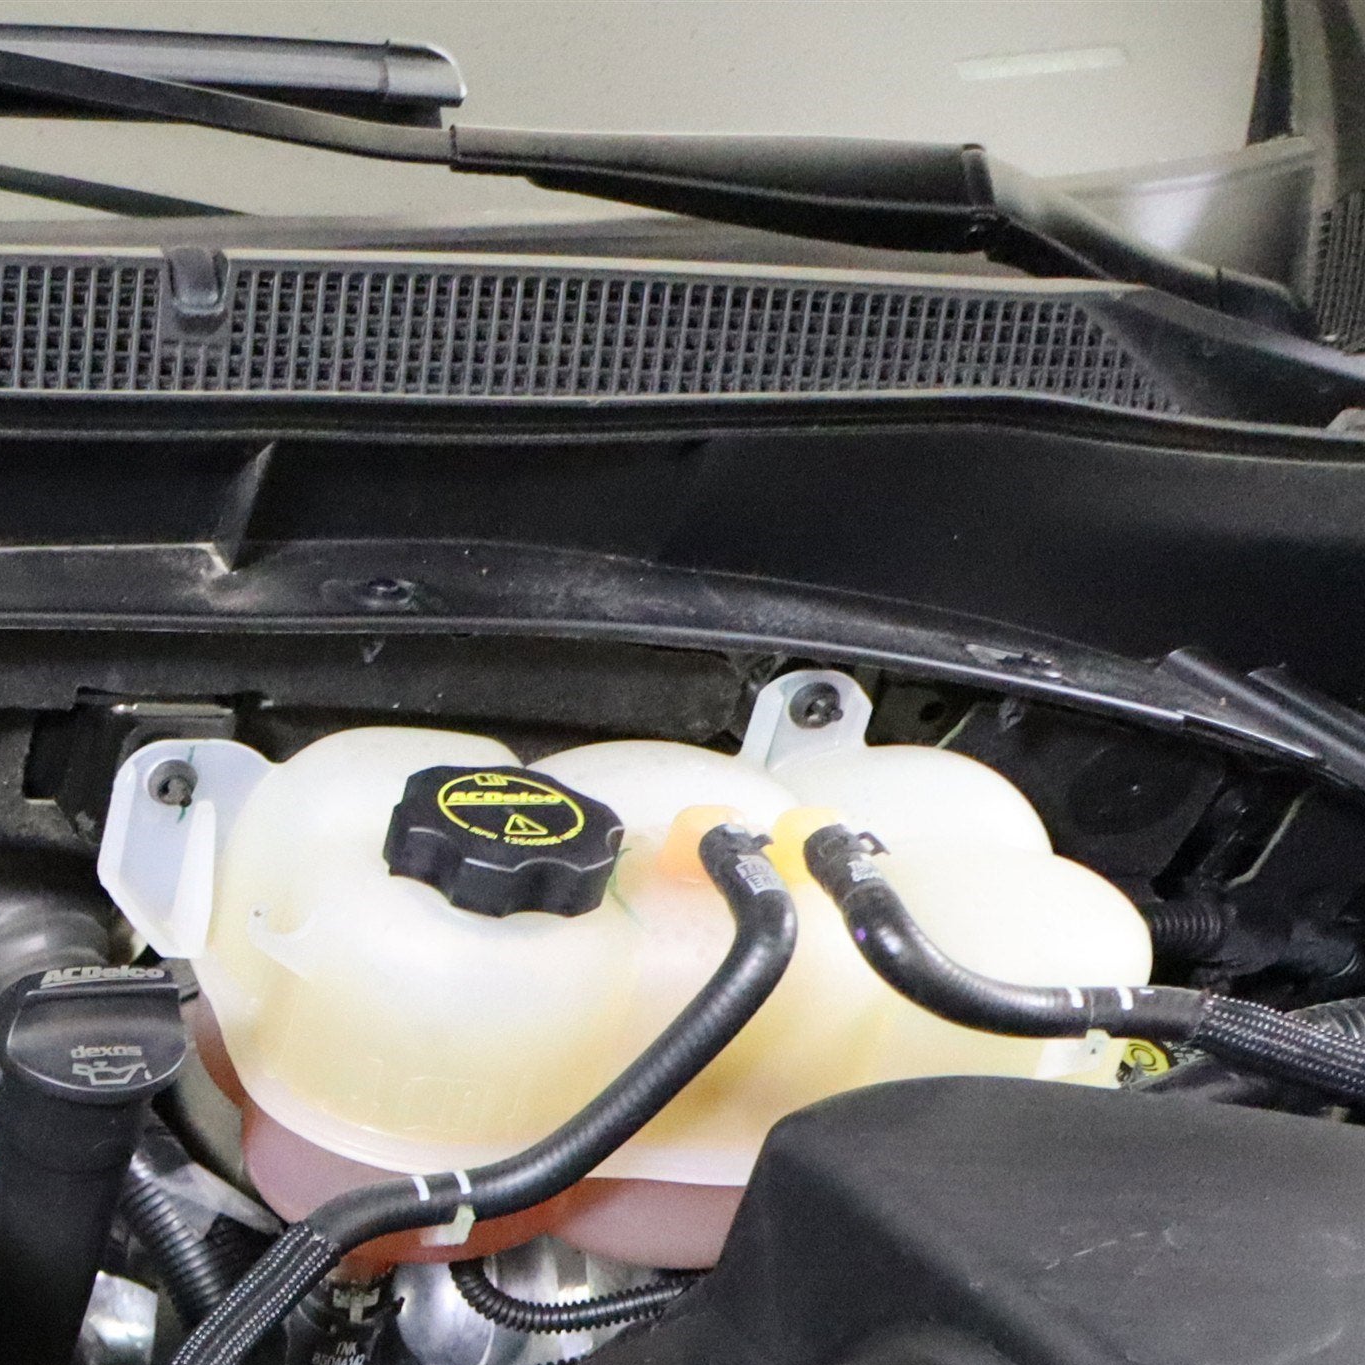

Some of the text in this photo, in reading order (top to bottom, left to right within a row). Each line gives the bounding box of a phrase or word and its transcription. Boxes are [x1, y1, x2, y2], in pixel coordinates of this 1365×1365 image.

[446, 791, 564, 804] ACDelco
[40, 965, 165, 987] ACDelco
[71, 1045, 142, 1058] dexos
